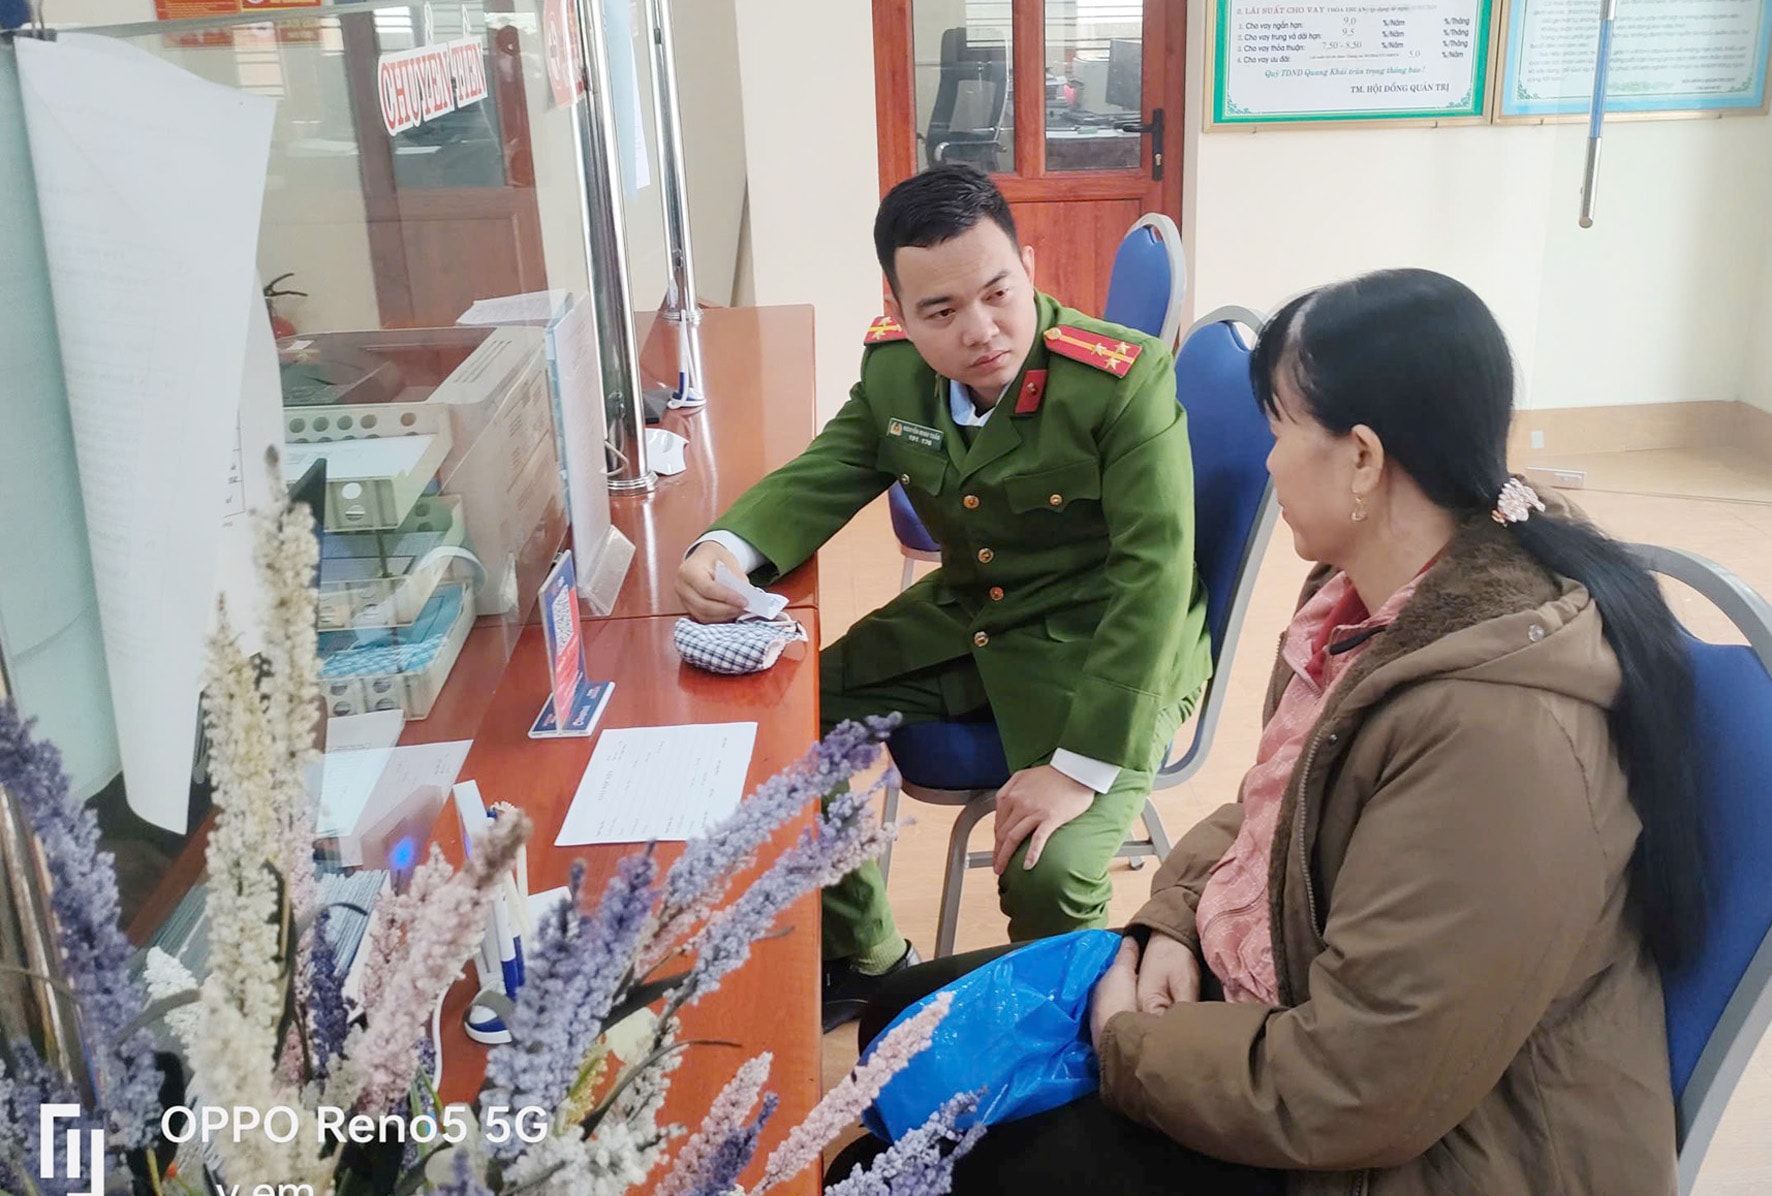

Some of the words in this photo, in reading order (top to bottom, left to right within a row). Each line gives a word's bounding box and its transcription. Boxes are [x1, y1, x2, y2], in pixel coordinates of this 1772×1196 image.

[1262, 5, 1284, 14] SUẤT
[1245, 22, 1258, 30] Cho
[1271, 33, 1287, 41] trung
[1281, 69, 1303, 77] TDND
[1304, 69, 1328, 77] Quang
[1367, 84, 1382, 94] HỘI
[1384, 82, 1408, 92] ĐỒNG
[1435, 83, 1449, 92] TRỊ
